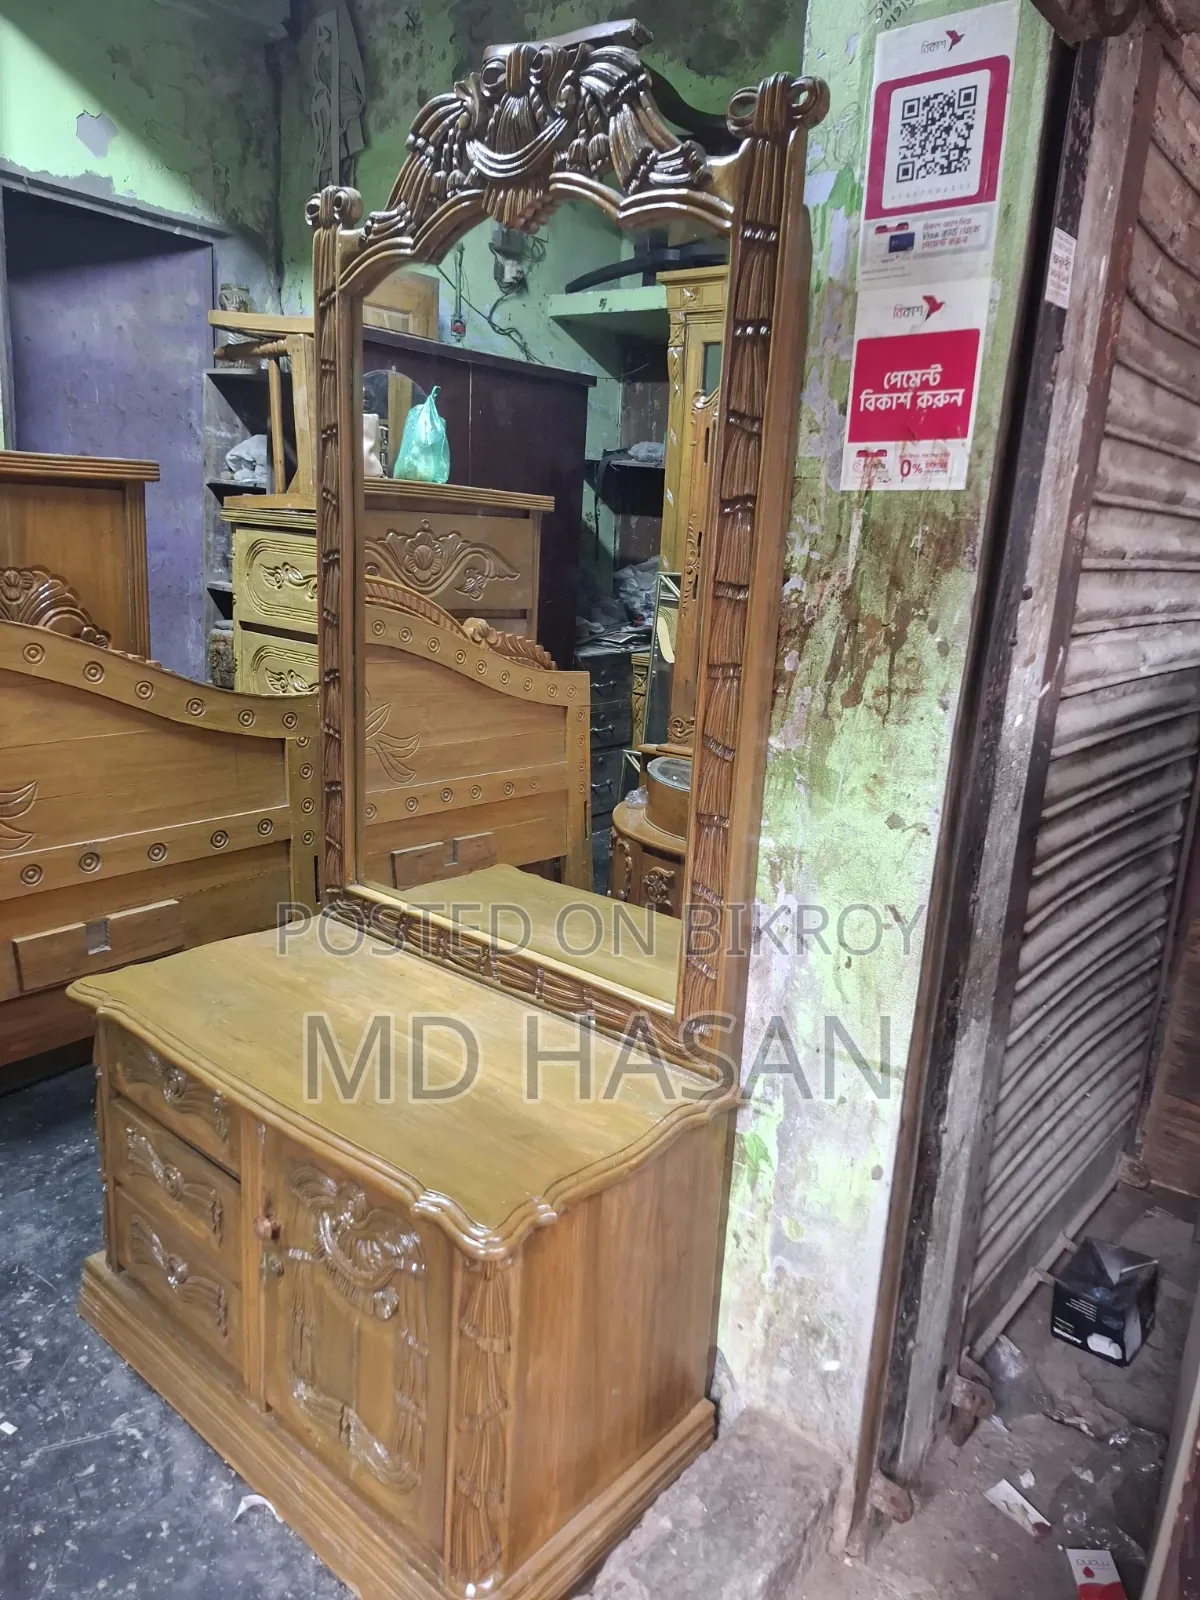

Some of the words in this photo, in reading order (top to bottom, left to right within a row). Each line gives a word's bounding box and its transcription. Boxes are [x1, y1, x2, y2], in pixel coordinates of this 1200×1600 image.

[921, 39, 947, 54] বিকাশ
[922, 230, 939, 241] Visa
[893, 303, 923, 320] বিকাশ
[883, 363, 943, 390] পেমেন্ট
[859, 388, 913, 412] বিকাশ
[916, 387, 965, 410] করুন
